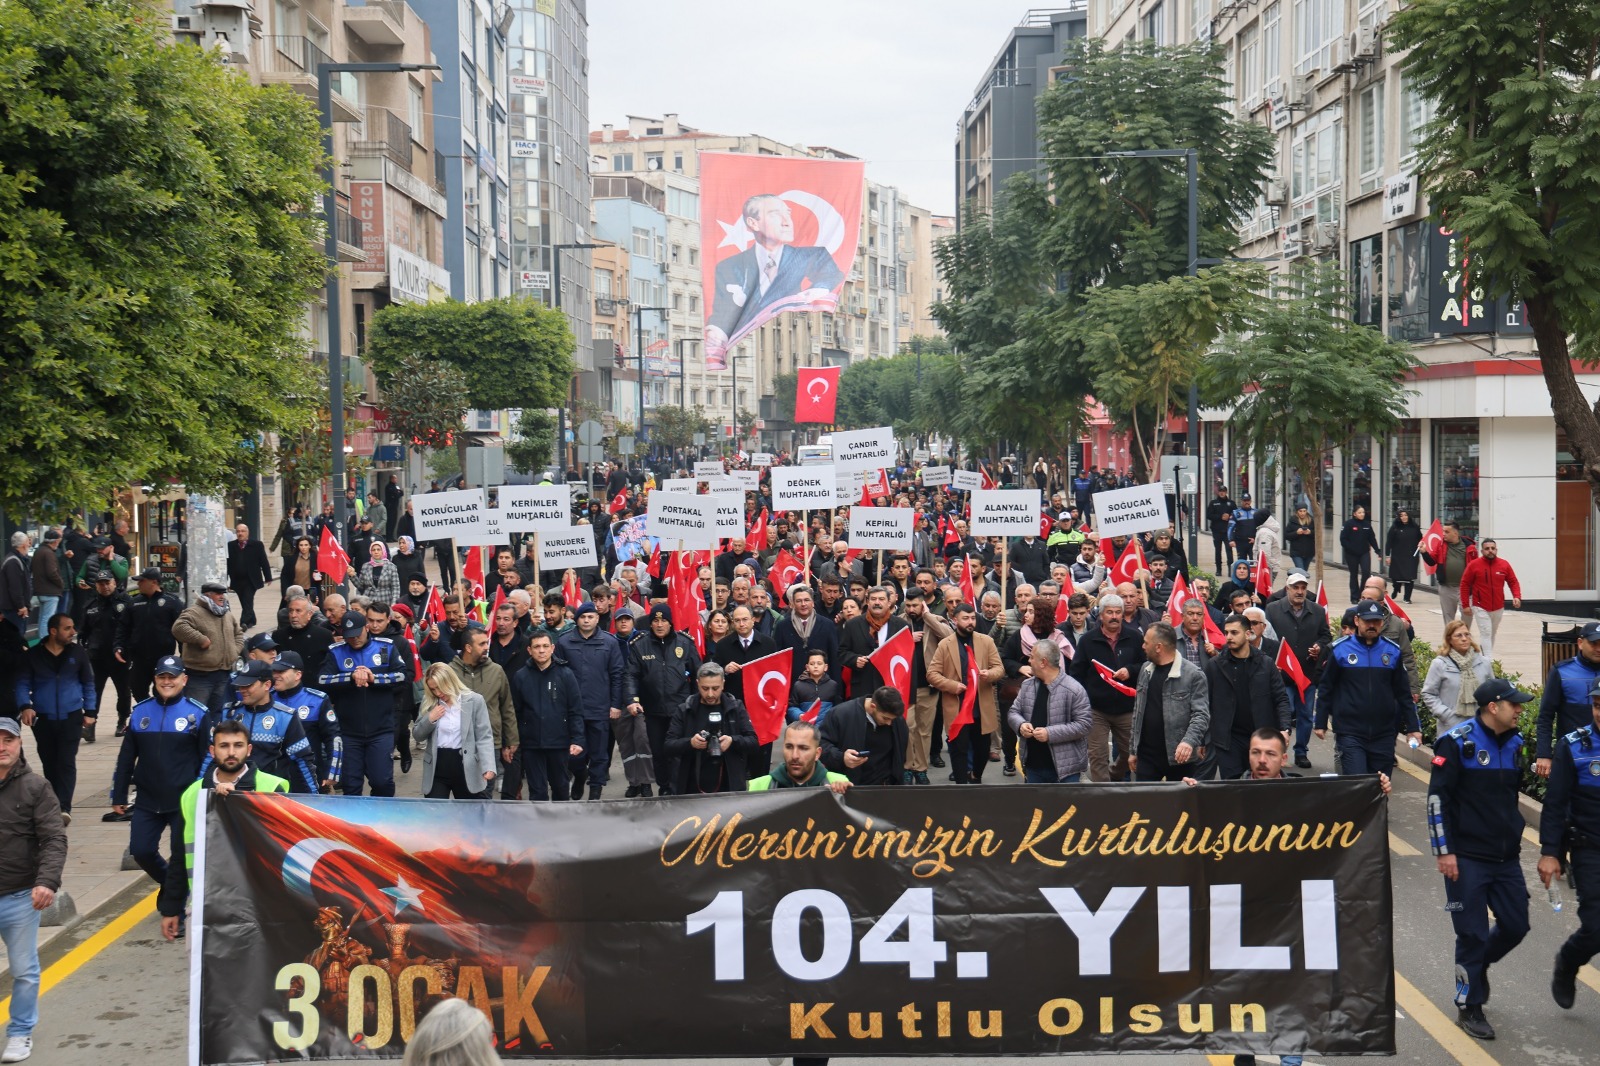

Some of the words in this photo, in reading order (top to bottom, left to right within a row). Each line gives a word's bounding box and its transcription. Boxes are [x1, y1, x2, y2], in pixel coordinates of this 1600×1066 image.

[360, 186, 374, 232] ONUR
[397, 257, 420, 295] ONUR
[848, 440, 878, 450] ÇANDIR
[840, 450, 889, 461] MUHTARLIĞI
[787, 479, 821, 487] DEĞNEK
[779, 490, 830, 499] MUHTARLIĞI
[511, 498, 558, 508] KERİMLER
[1108, 498, 1152, 512] SOĞUCAK
[421, 503, 478, 516] KORUCULAR
[506, 510, 563, 520] MUHTARLIĞI
[662, 505, 702, 516] PORTAKAL
[422, 515, 480, 528] MUHTARLIĞI
[658, 516, 705, 529] MUHTARLIĞI
[716, 518, 738, 526] RLIĞI
[978, 514, 1033, 523] MUHTARLIĞI
[1104, 509, 1160, 525] MUHTARLIĞI
[865, 519, 898, 527] KEPİRLİ
[855, 530, 906, 539] MUHTARLIĞI
[545, 537, 586, 547] KURUDERE
[544, 548, 590, 558] MUHTARLIĞI
[1010, 804, 1363, 867] Kurtuluşunun
[685, 886, 989, 981] 104.
[1039, 879, 1339, 977] YILI
[273, 963, 320, 1051] 3
[789, 1001, 1003, 1040] Kutlu
[1038, 997, 1268, 1037] Olsun
